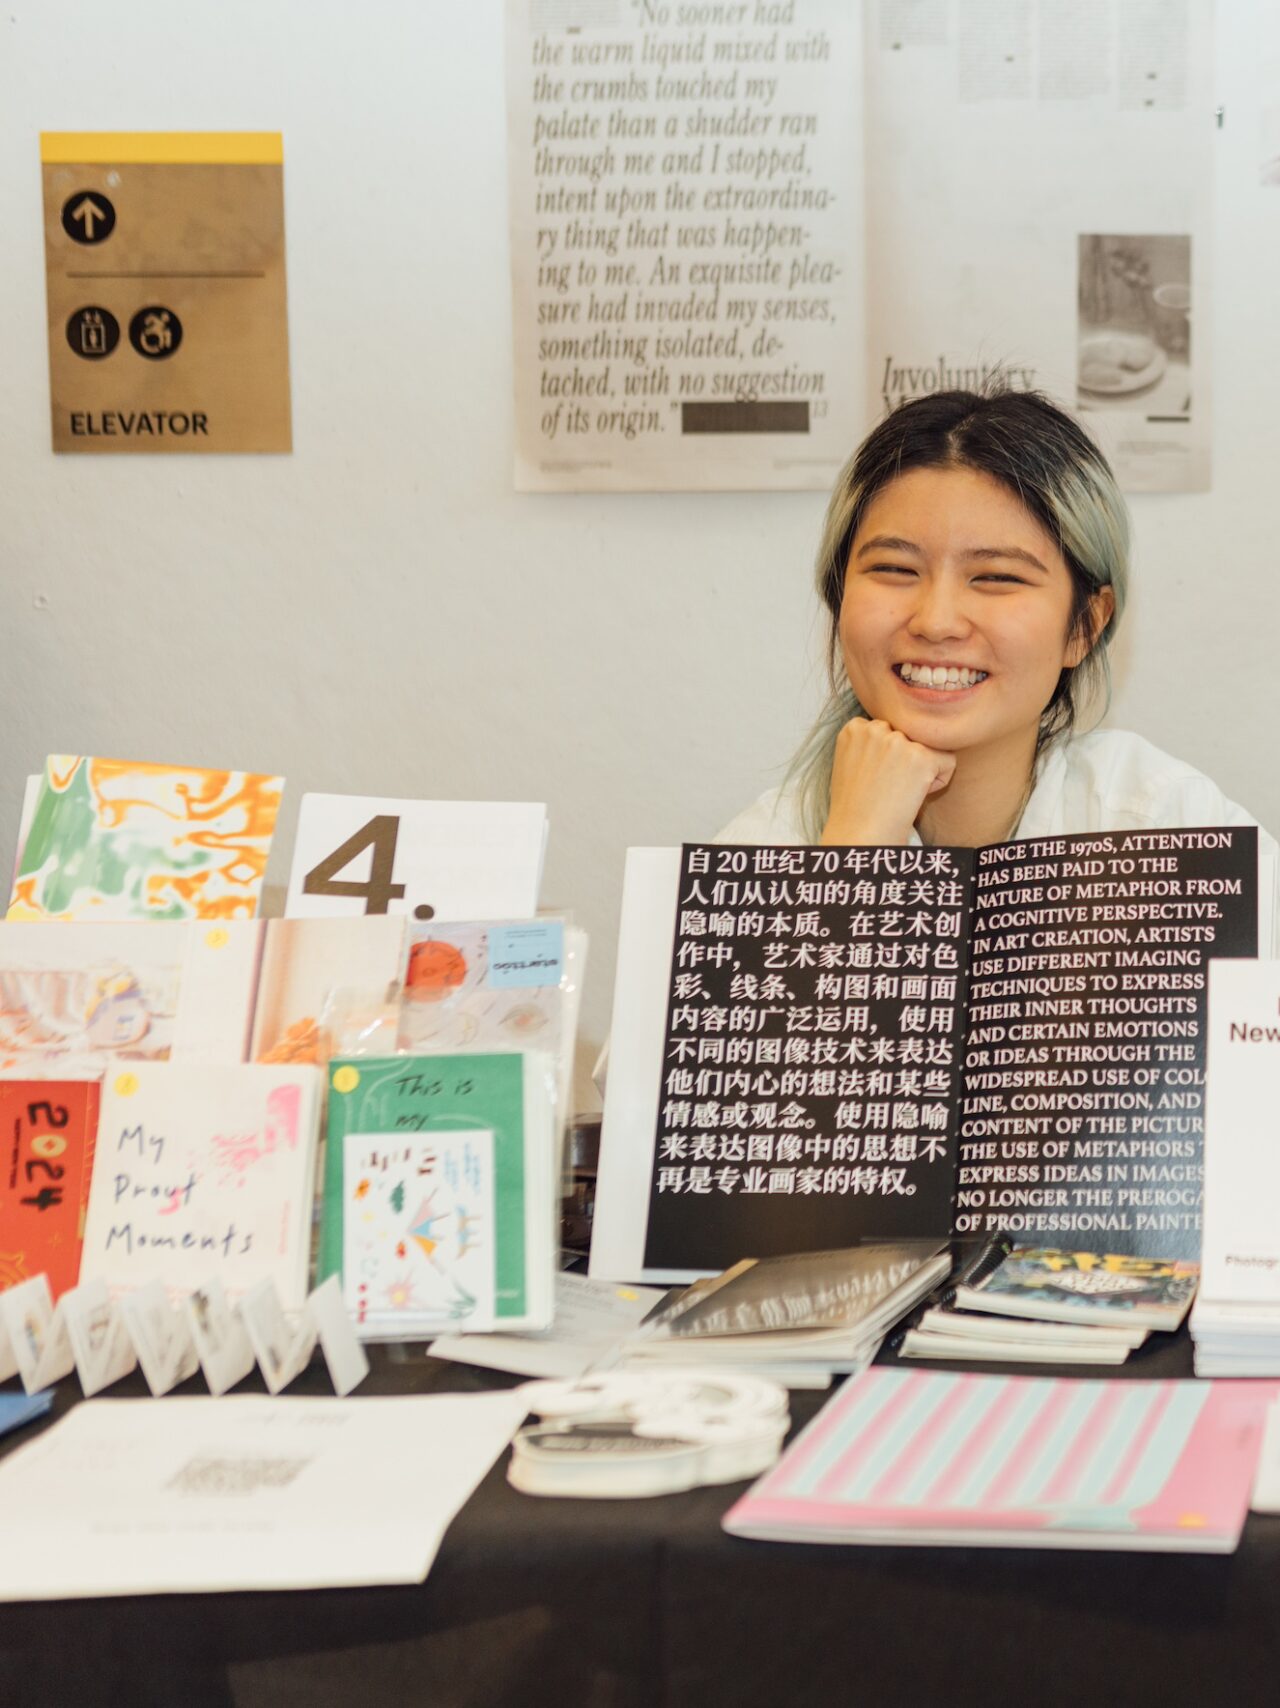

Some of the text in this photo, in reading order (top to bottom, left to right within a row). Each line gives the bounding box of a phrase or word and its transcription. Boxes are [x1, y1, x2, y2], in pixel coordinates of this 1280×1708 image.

[676, 0, 794, 27] sooner had
[533, 29, 830, 71] the warm liquid mixed with
[533, 69, 778, 105] the crumbs touched my
[534, 108, 817, 145] palate than a shudder ran
[534, 144, 812, 182] through me and I stopped,
[536, 180, 836, 218] intent upon the extraordina-
[536, 219, 810, 252] ry thing that was happen-
[538, 254, 841, 298] ing to me. An exquisite plea-
[538, 287, 836, 326] sure had invaded my senses,
[538, 329, 784, 366] something isolated, de-
[541, 364, 824, 401] tached, with no suggestion
[70, 411, 208, 435] ELEVATOR
[541, 405, 559, 439] of
[566, 403, 589, 432] its
[979, 833, 1233, 865] SINCE THE 1970S, ATTENTION
[977, 857, 1178, 888] HAS BEEN PAID TO THE
[681, 880, 964, 906] 人们从认知的角度关注
[976, 879, 1242, 910] NATURE OF METAPHOR FROM
[679, 911, 962, 937] 隐喻的本质。在艺术创
[974, 903, 1223, 932] A COGNITIVE PERSPECTIVE.
[973, 926, 1215, 955] IN ART CREATION, ARTISTS
[677, 943, 959, 971] 作中，艺术家通过对色
[973, 950, 1200, 976] USE DIFFERENT IMAGING
[673, 974, 957, 1001] 彩、线条、构图和画面
[971, 974, 1204, 1000] TECHNIQUES TO EXPRESS
[671, 1005, 954, 1035] 内容的广泛运用，使用
[969, 997, 1197, 1022] THEIR INNER THOUGHTS
[967, 1021, 1198, 1046] AND CERTAIN EMOTIONS
[667, 1037, 954, 1065] 不同的图像技术来表达
[966, 1045, 1195, 1068] OR IDEAS THROUGH THE
[397, 1074, 476, 1096] This is
[665, 1069, 951, 1098] 他们内心的想法和某些
[965, 1068, 1208, 1091] WIDESPREAD USE OF COL
[963, 1093, 1201, 1114] LINE, COMPOSITION, AND
[395, 1114, 430, 1131] my
[961, 1118, 1052, 1137] CONTENT
[1056, 1118, 1083, 1134] OF
[1086, 1118, 1127, 1134] THE
[20, 1101, 69, 1212] 2024
[117, 1125, 165, 1163] My
[659, 1133, 948, 1163] 来表达图像中的思想不
[960, 1141, 1195, 1161] THE USE OF METAPHORS
[656, 1166, 917, 1196] 再是专业画家的特权。
[959, 1166, 1039, 1184] EXPRESS
[1044, 1165, 1102, 1182] IDEAS
[1107, 1165, 1128, 1181] IN
[958, 1189, 1114, 1208] NO LONGER THE
[956, 1214, 982, 1231] OF
[986, 1213, 1131, 1231] PROFESSIONAL
[105, 1223, 254, 1258] Moments
